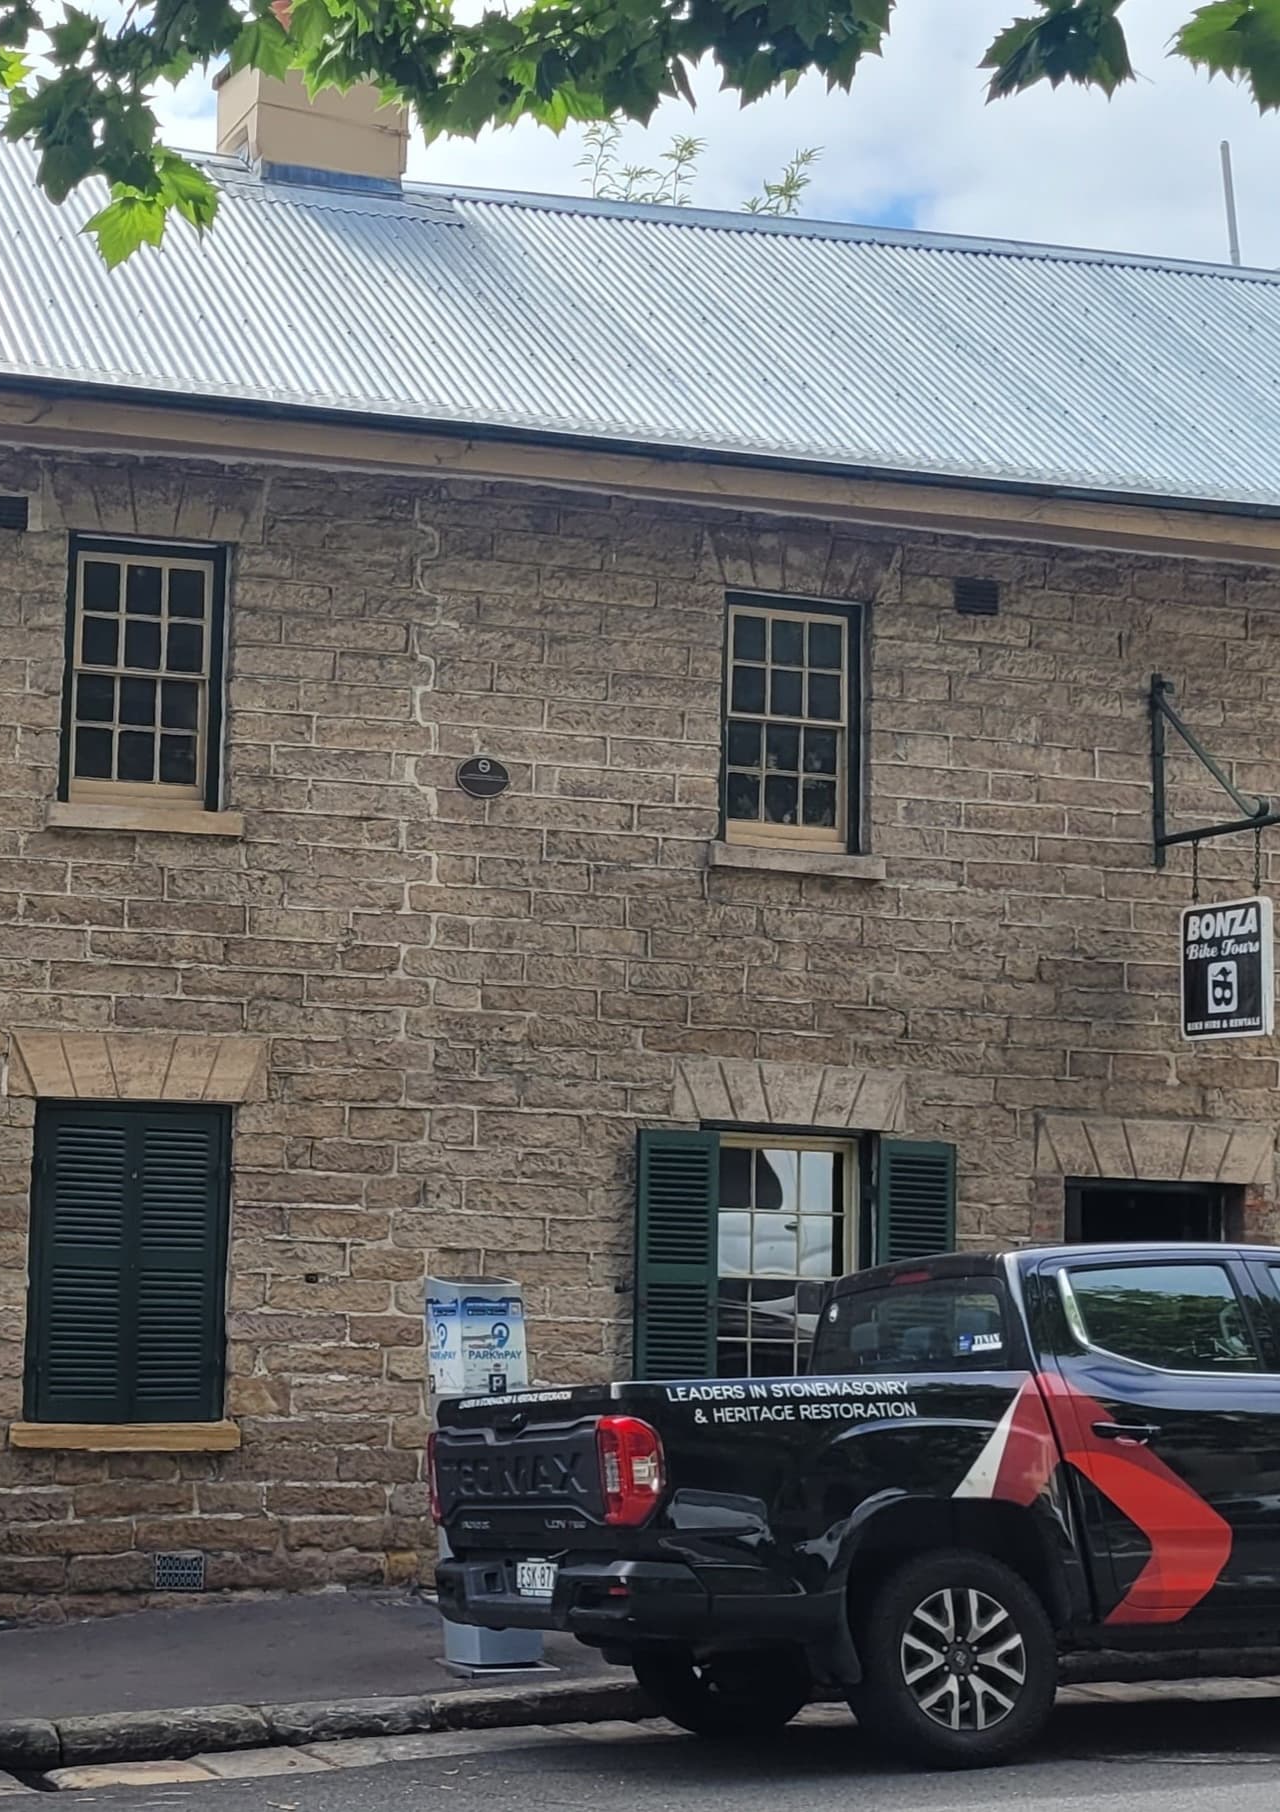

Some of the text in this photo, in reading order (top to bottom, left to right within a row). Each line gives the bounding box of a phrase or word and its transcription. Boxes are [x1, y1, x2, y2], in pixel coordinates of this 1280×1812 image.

[1186, 907, 1258, 942] BONZA
[1185, 938, 1260, 961] Bike Tours
[492, 1375, 503, 1392] P
[666, 1380, 910, 1402] LEADERS IN STONEMASONRY
[694, 1401, 918, 1424] & HERITAGE RESTORATION
[497, 1452, 589, 1496] MAX
